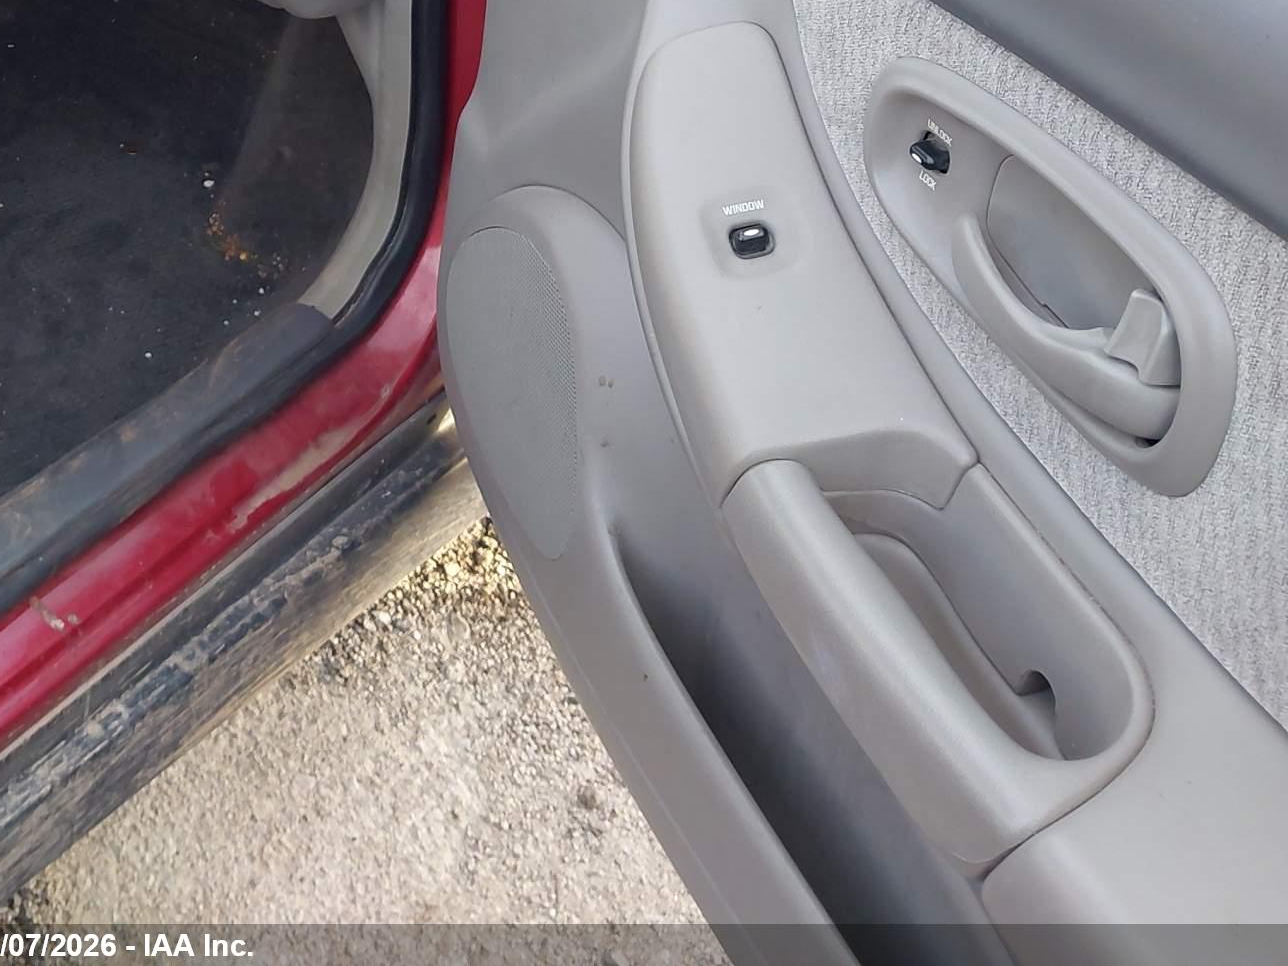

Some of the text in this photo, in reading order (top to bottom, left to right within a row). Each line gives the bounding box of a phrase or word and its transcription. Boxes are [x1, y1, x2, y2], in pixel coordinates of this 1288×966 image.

[927, 118, 953, 147] UNLOCK
[919, 170, 937, 191] LOCK
[722, 199, 764, 216] WINDOW
